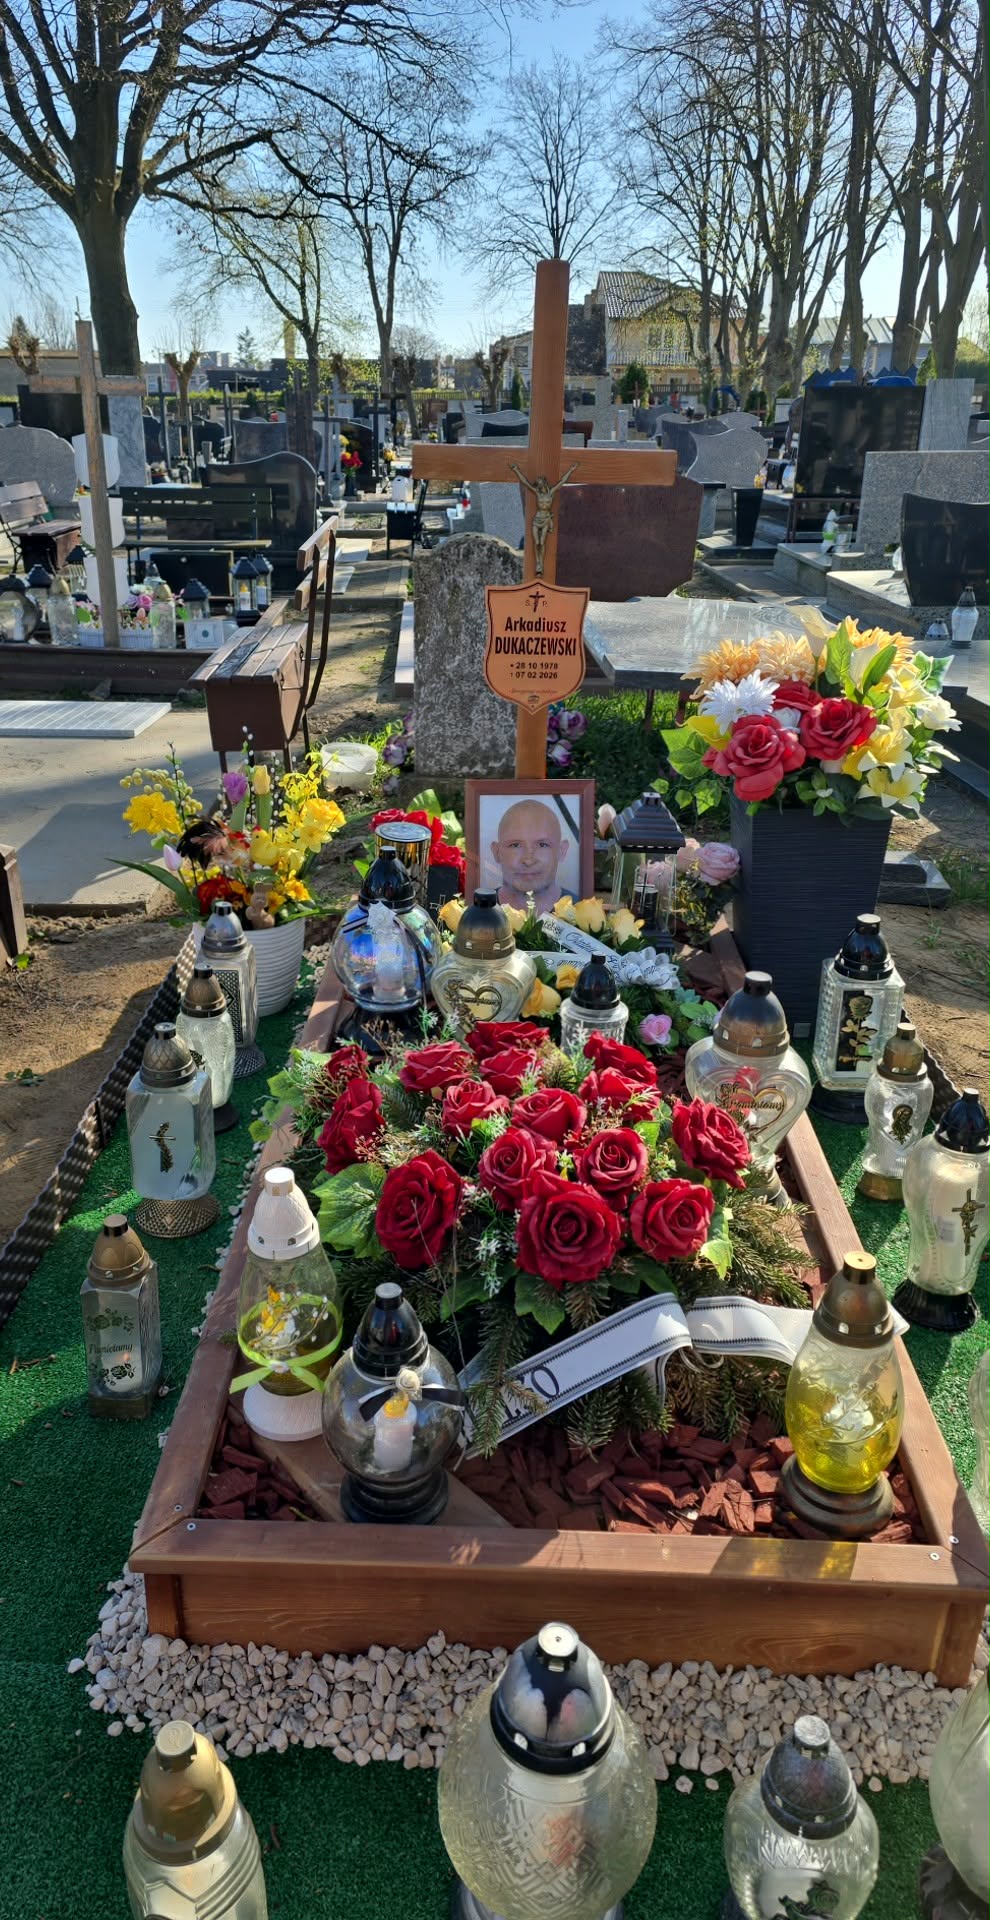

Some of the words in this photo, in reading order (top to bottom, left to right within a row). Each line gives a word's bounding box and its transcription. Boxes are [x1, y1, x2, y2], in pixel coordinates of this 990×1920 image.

[505, 616, 567, 633] Arkadiusz
[495, 636, 577, 656] DUKACZEWSKI
[515, 671, 525, 679] 07
[527, 671, 537, 679] 02
[539, 671, 558, 679] 2026
